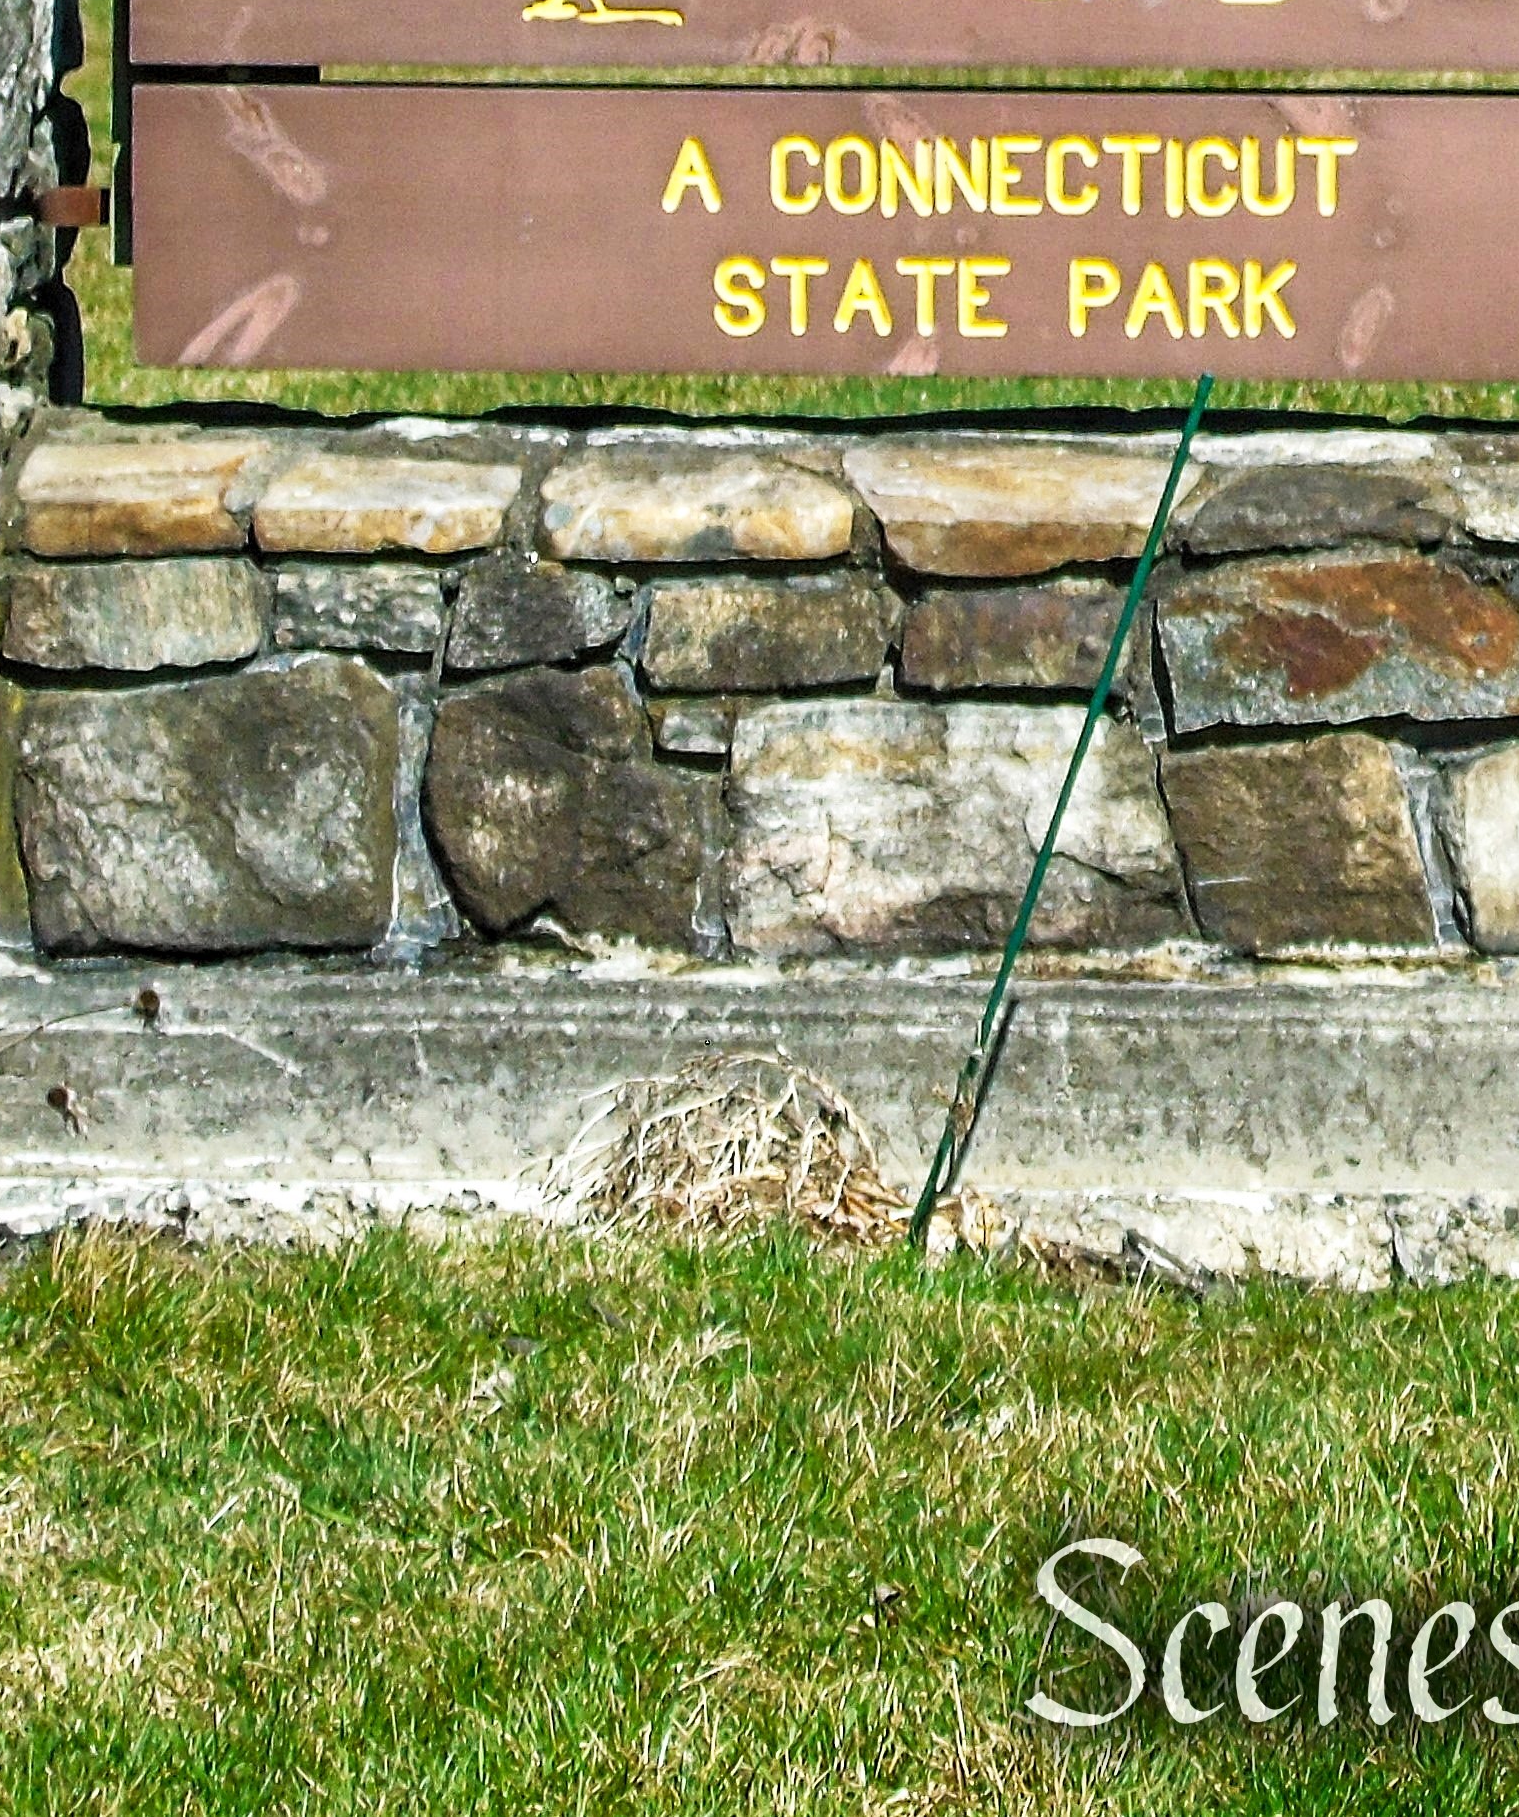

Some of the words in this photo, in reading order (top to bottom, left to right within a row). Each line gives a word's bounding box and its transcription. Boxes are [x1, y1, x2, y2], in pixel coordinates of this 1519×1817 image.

[659, 133, 724, 215] A
[769, 131, 1360, 219] CONNECTICUT
[712, 253, 1012, 341] STATE
[1066, 253, 1302, 339] PARK
